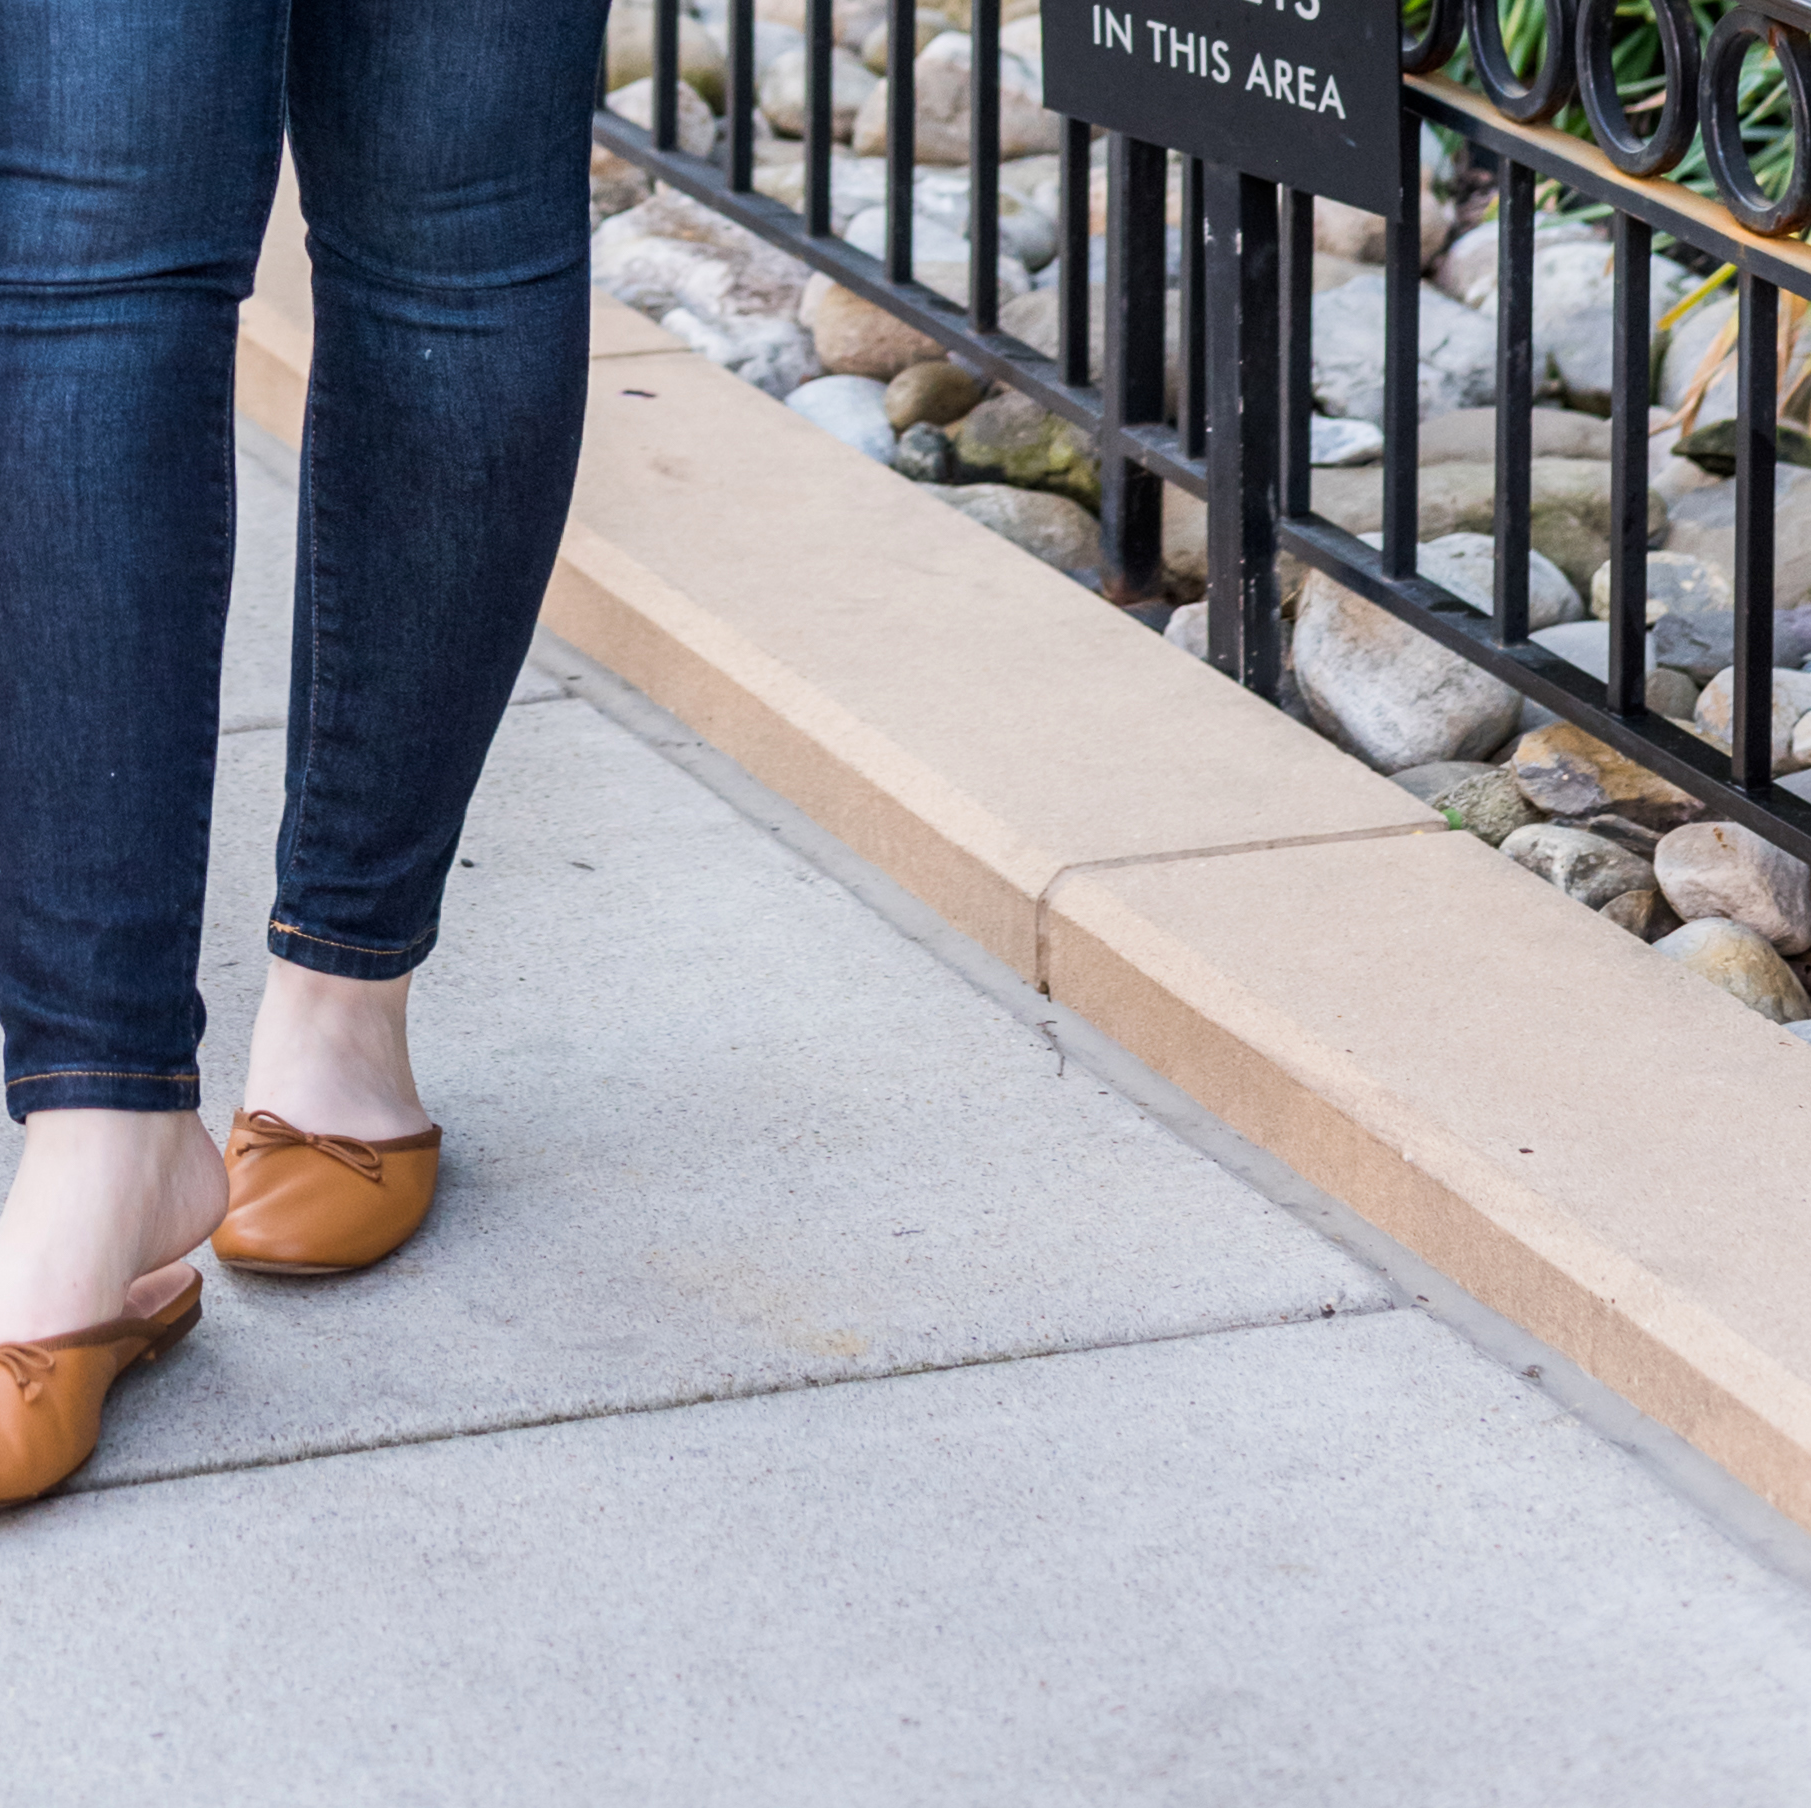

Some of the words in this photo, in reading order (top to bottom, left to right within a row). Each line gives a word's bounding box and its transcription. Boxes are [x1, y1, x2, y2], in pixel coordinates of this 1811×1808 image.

[1092, 4, 1133, 54] IN
[1146, 20, 1231, 84] THIS
[1245, 52, 1347, 120] AREA
